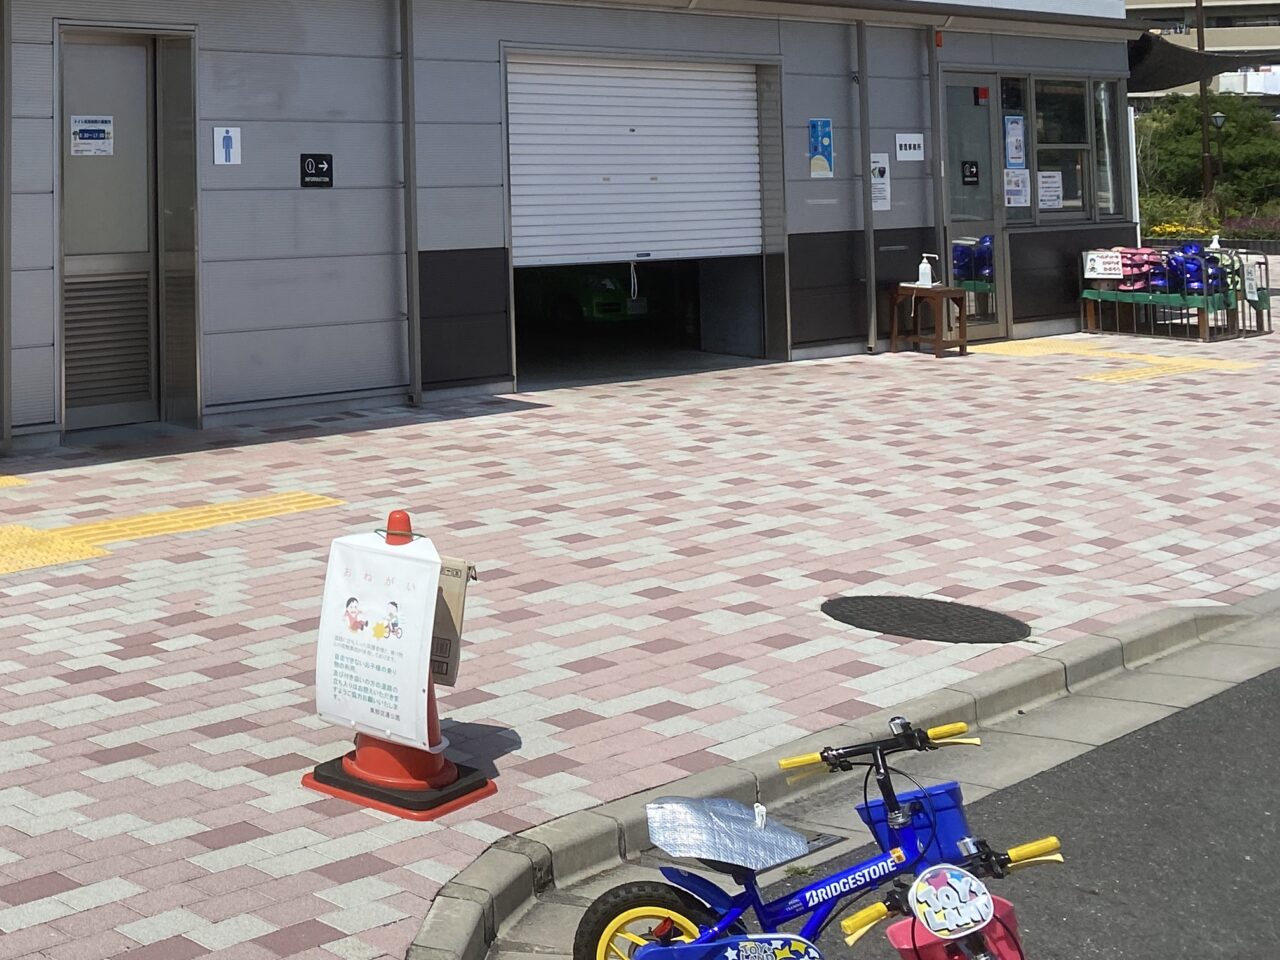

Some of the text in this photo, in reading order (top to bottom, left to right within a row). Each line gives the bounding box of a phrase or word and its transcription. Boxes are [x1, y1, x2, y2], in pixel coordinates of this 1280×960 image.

[805, 858, 897, 907] BRIDGESTONE
[917, 877, 972, 914] TOY
[924, 896, 990, 932] LAND
[740, 943, 768, 954] TOY
